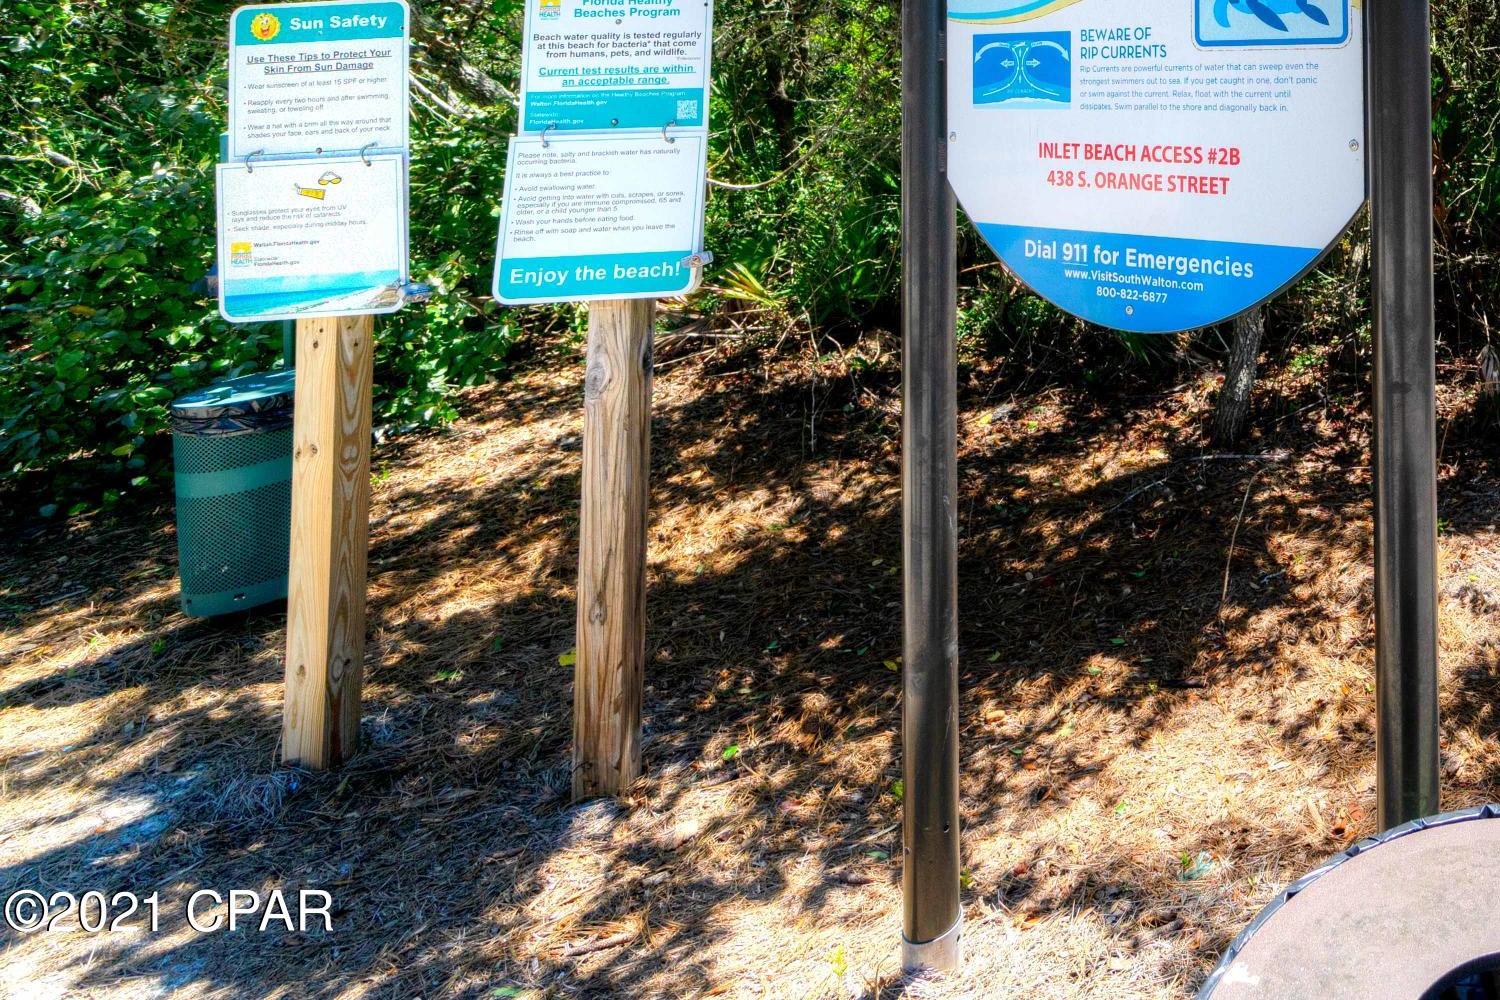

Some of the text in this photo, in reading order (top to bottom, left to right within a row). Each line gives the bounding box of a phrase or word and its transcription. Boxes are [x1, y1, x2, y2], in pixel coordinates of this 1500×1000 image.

[574, 8, 680, 18] Beaches Program
[290, 15, 387, 30] Sun Safety
[591, 33, 620, 41] quality
[1080, 27, 1151, 42] BEWARE OF
[268, 54, 295, 62] These
[299, 53, 318, 61] Tips
[611, 50, 631, 58] pets,
[1080, 45, 1166, 59] RIP CURRENTS
[336, 61, 373, 70] Damage
[539, 67, 579, 76] Current
[582, 67, 601, 75] test
[605, 66, 639, 74] results
[1080, 66, 1090, 74] Rip
[1134, 64, 1162, 73] powerful
[1259, 64, 1283, 72] sweep
[578, 77, 634, 86] acceptable
[1039, 143, 1240, 165] INLET BEACH ACCESS #2B
[1047, 170, 1229, 194] 438 S. ORANGE STREET
[1025, 240, 1253, 278] Dial 911 for Emergencies
[510, 261, 680, 286] Enjoy the beach!
[1064, 269, 1203, 291] www.VisitSouthWalton.com
[1097, 286, 1167, 303] 800-822-6877
